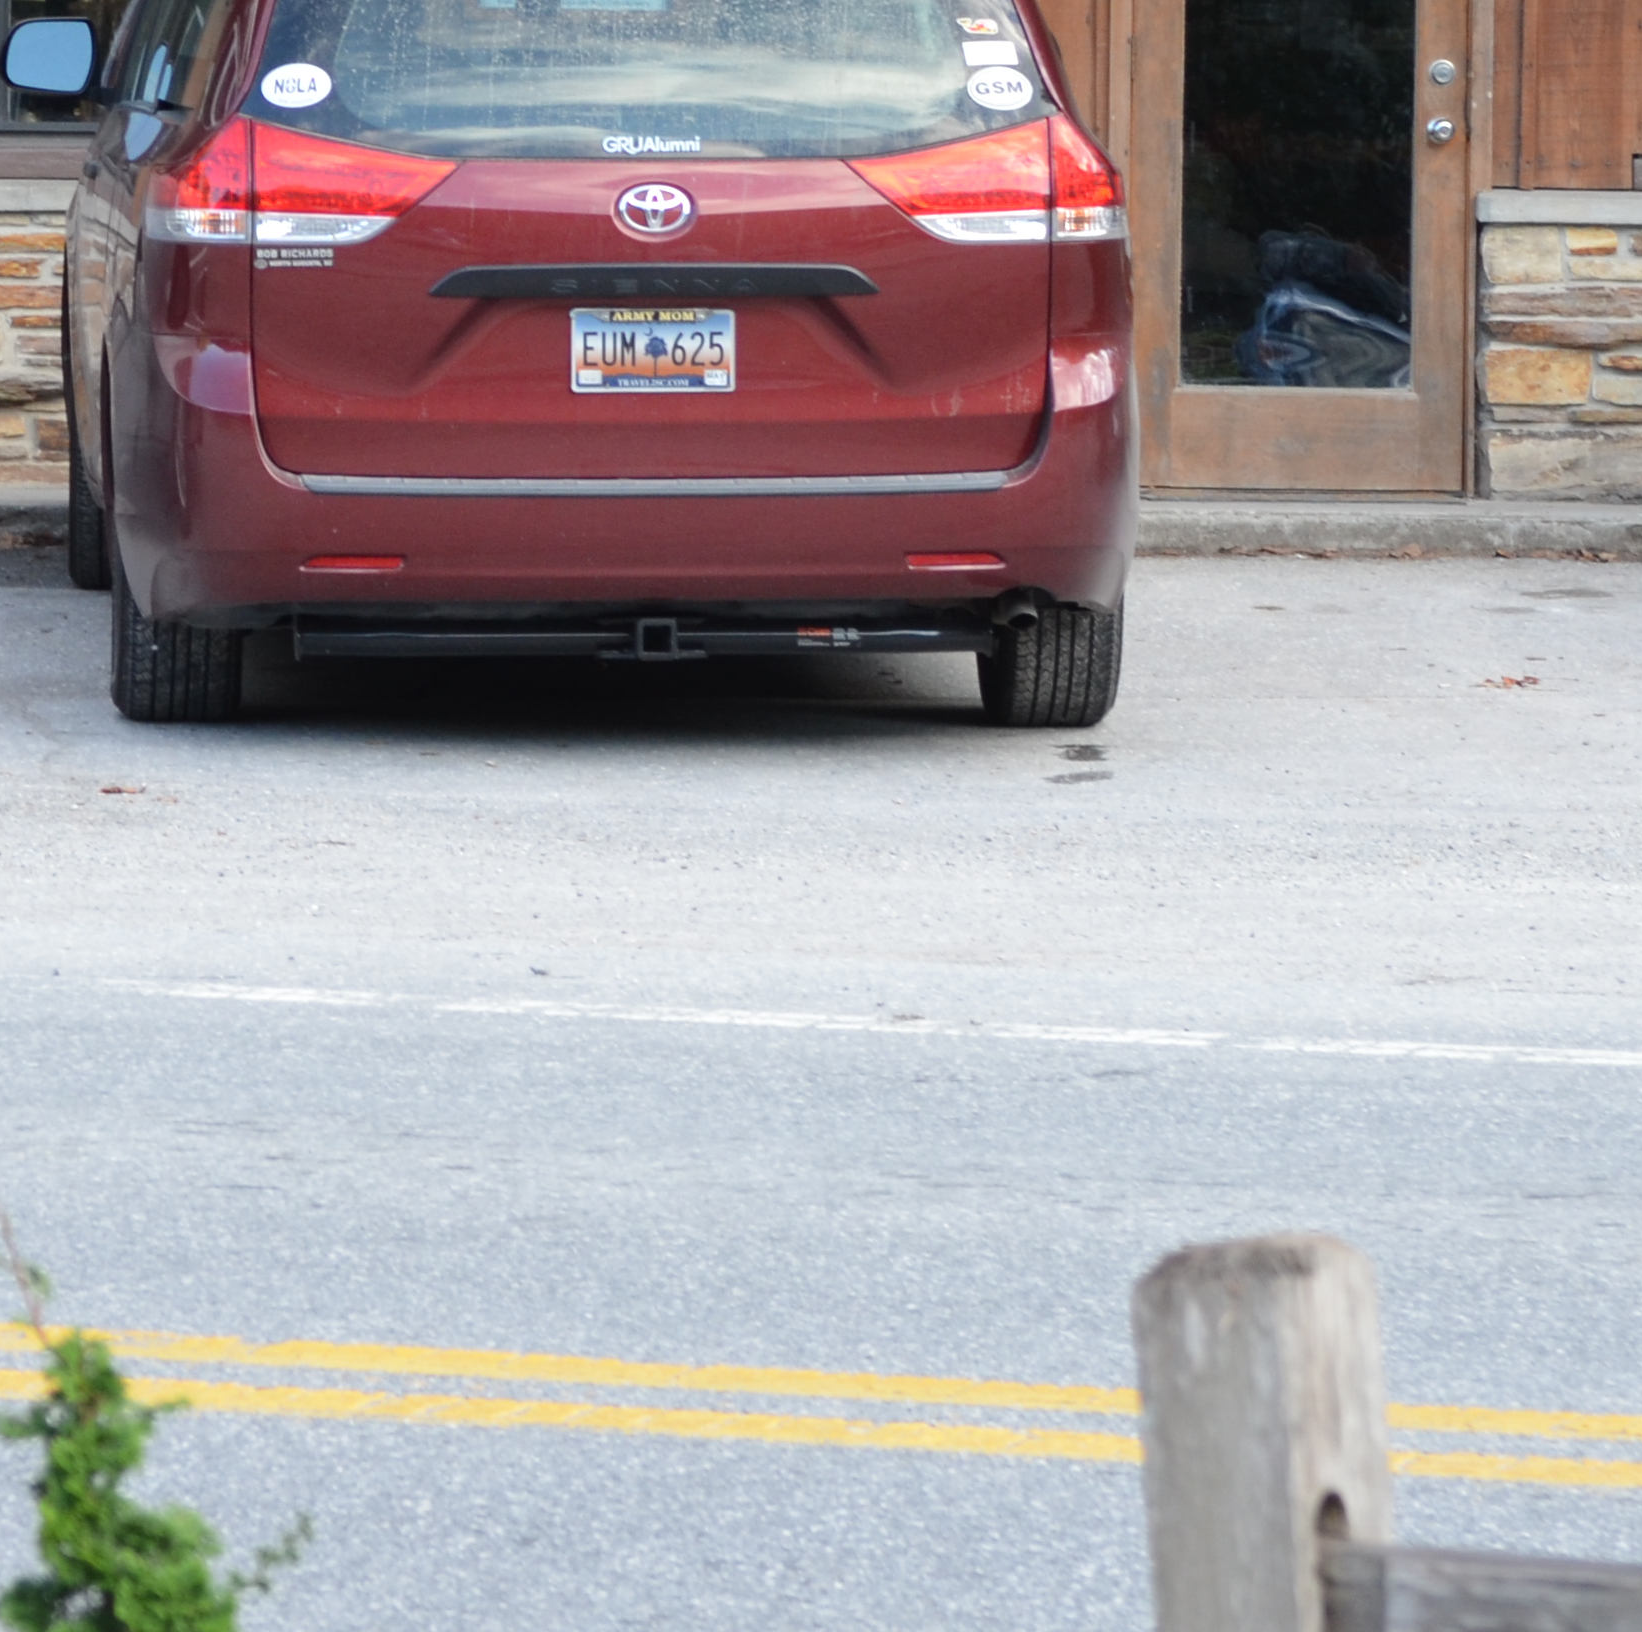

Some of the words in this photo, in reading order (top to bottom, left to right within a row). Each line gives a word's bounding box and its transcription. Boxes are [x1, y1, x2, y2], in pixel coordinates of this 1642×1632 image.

[274, 78, 318, 95] NOLA
[975, 81, 1024, 96] GSM
[257, 248, 278, 259] BOB
[280, 248, 334, 259] RICHARDS
[612, 310, 655, 322] ARMY
[659, 311, 695, 322] MOM
[582, 331, 636, 367] EUM
[671, 331, 725, 367] 625
